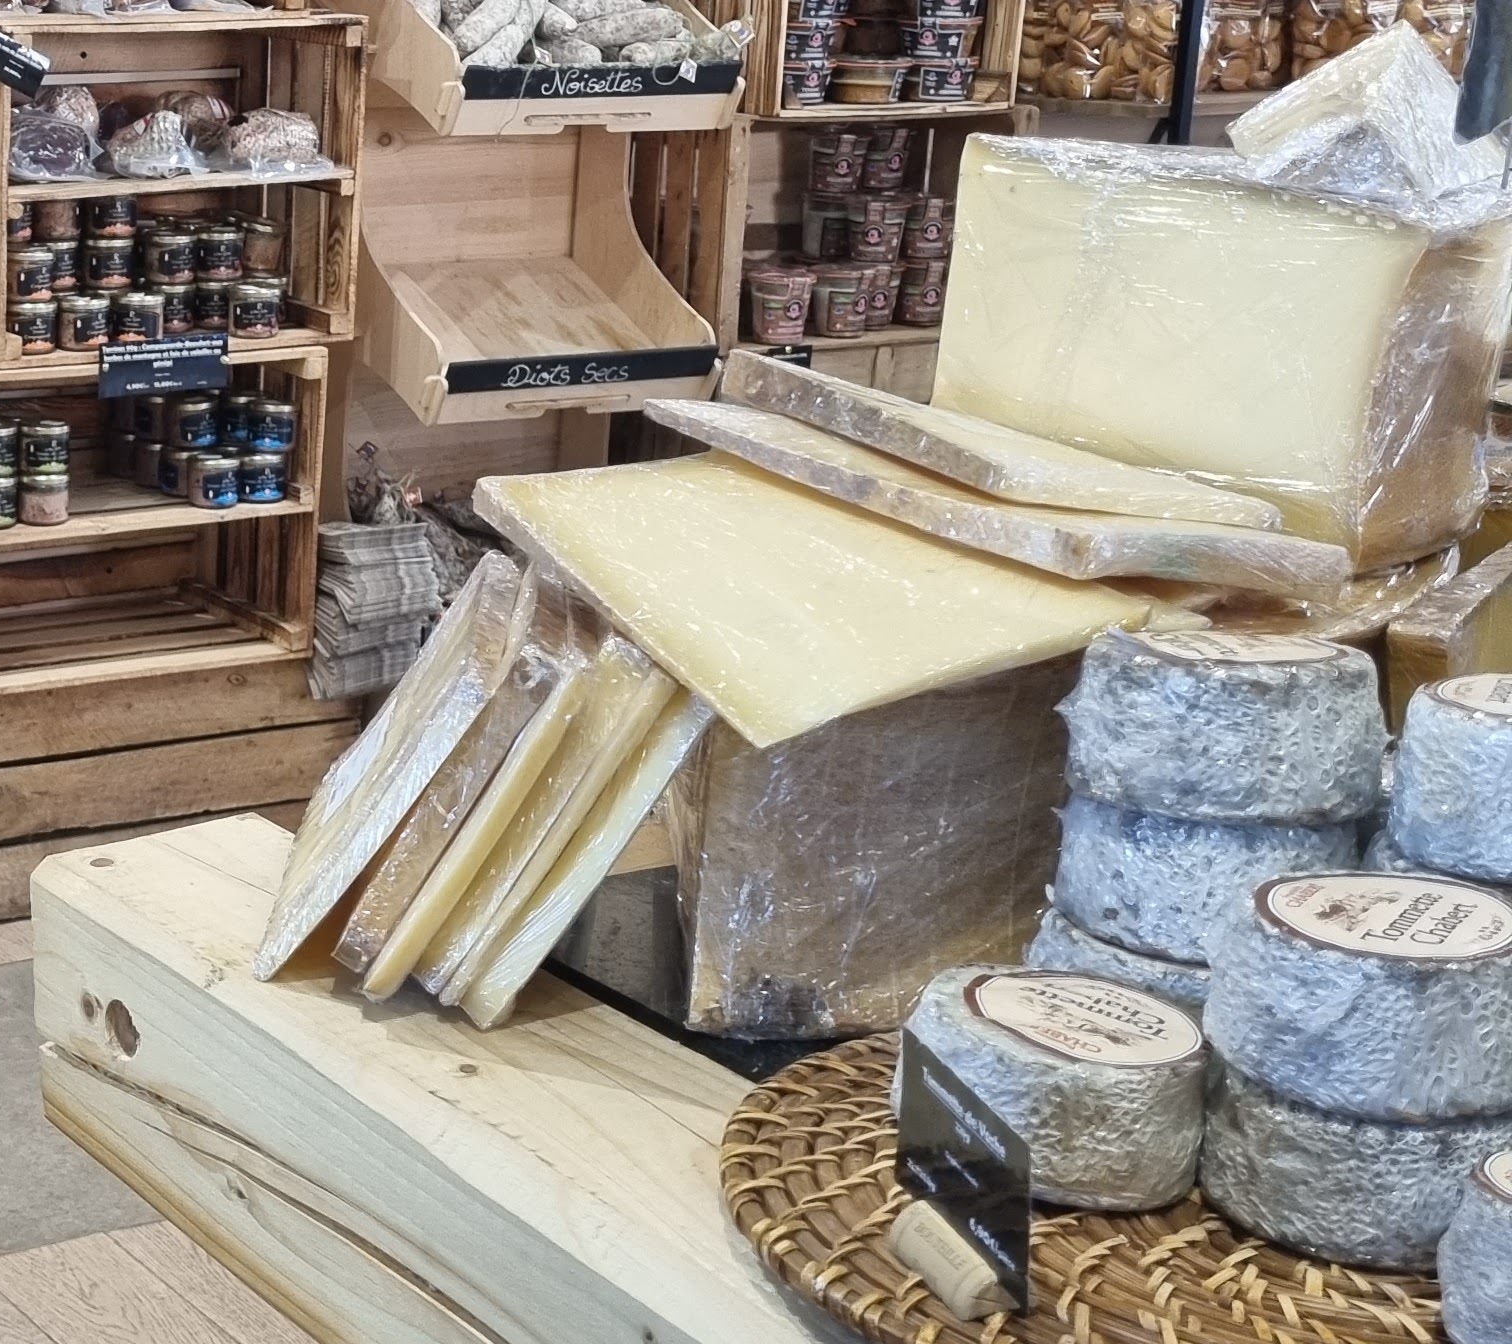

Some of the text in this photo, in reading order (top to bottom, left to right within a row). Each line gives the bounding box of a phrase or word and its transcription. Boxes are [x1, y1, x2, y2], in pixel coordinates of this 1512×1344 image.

[541, 69, 643, 97] Noisettes
[501, 361, 631, 388] Diots Secs
[1360, 892, 1444, 942] Tommette
[1409, 902, 1479, 945] Chabert
